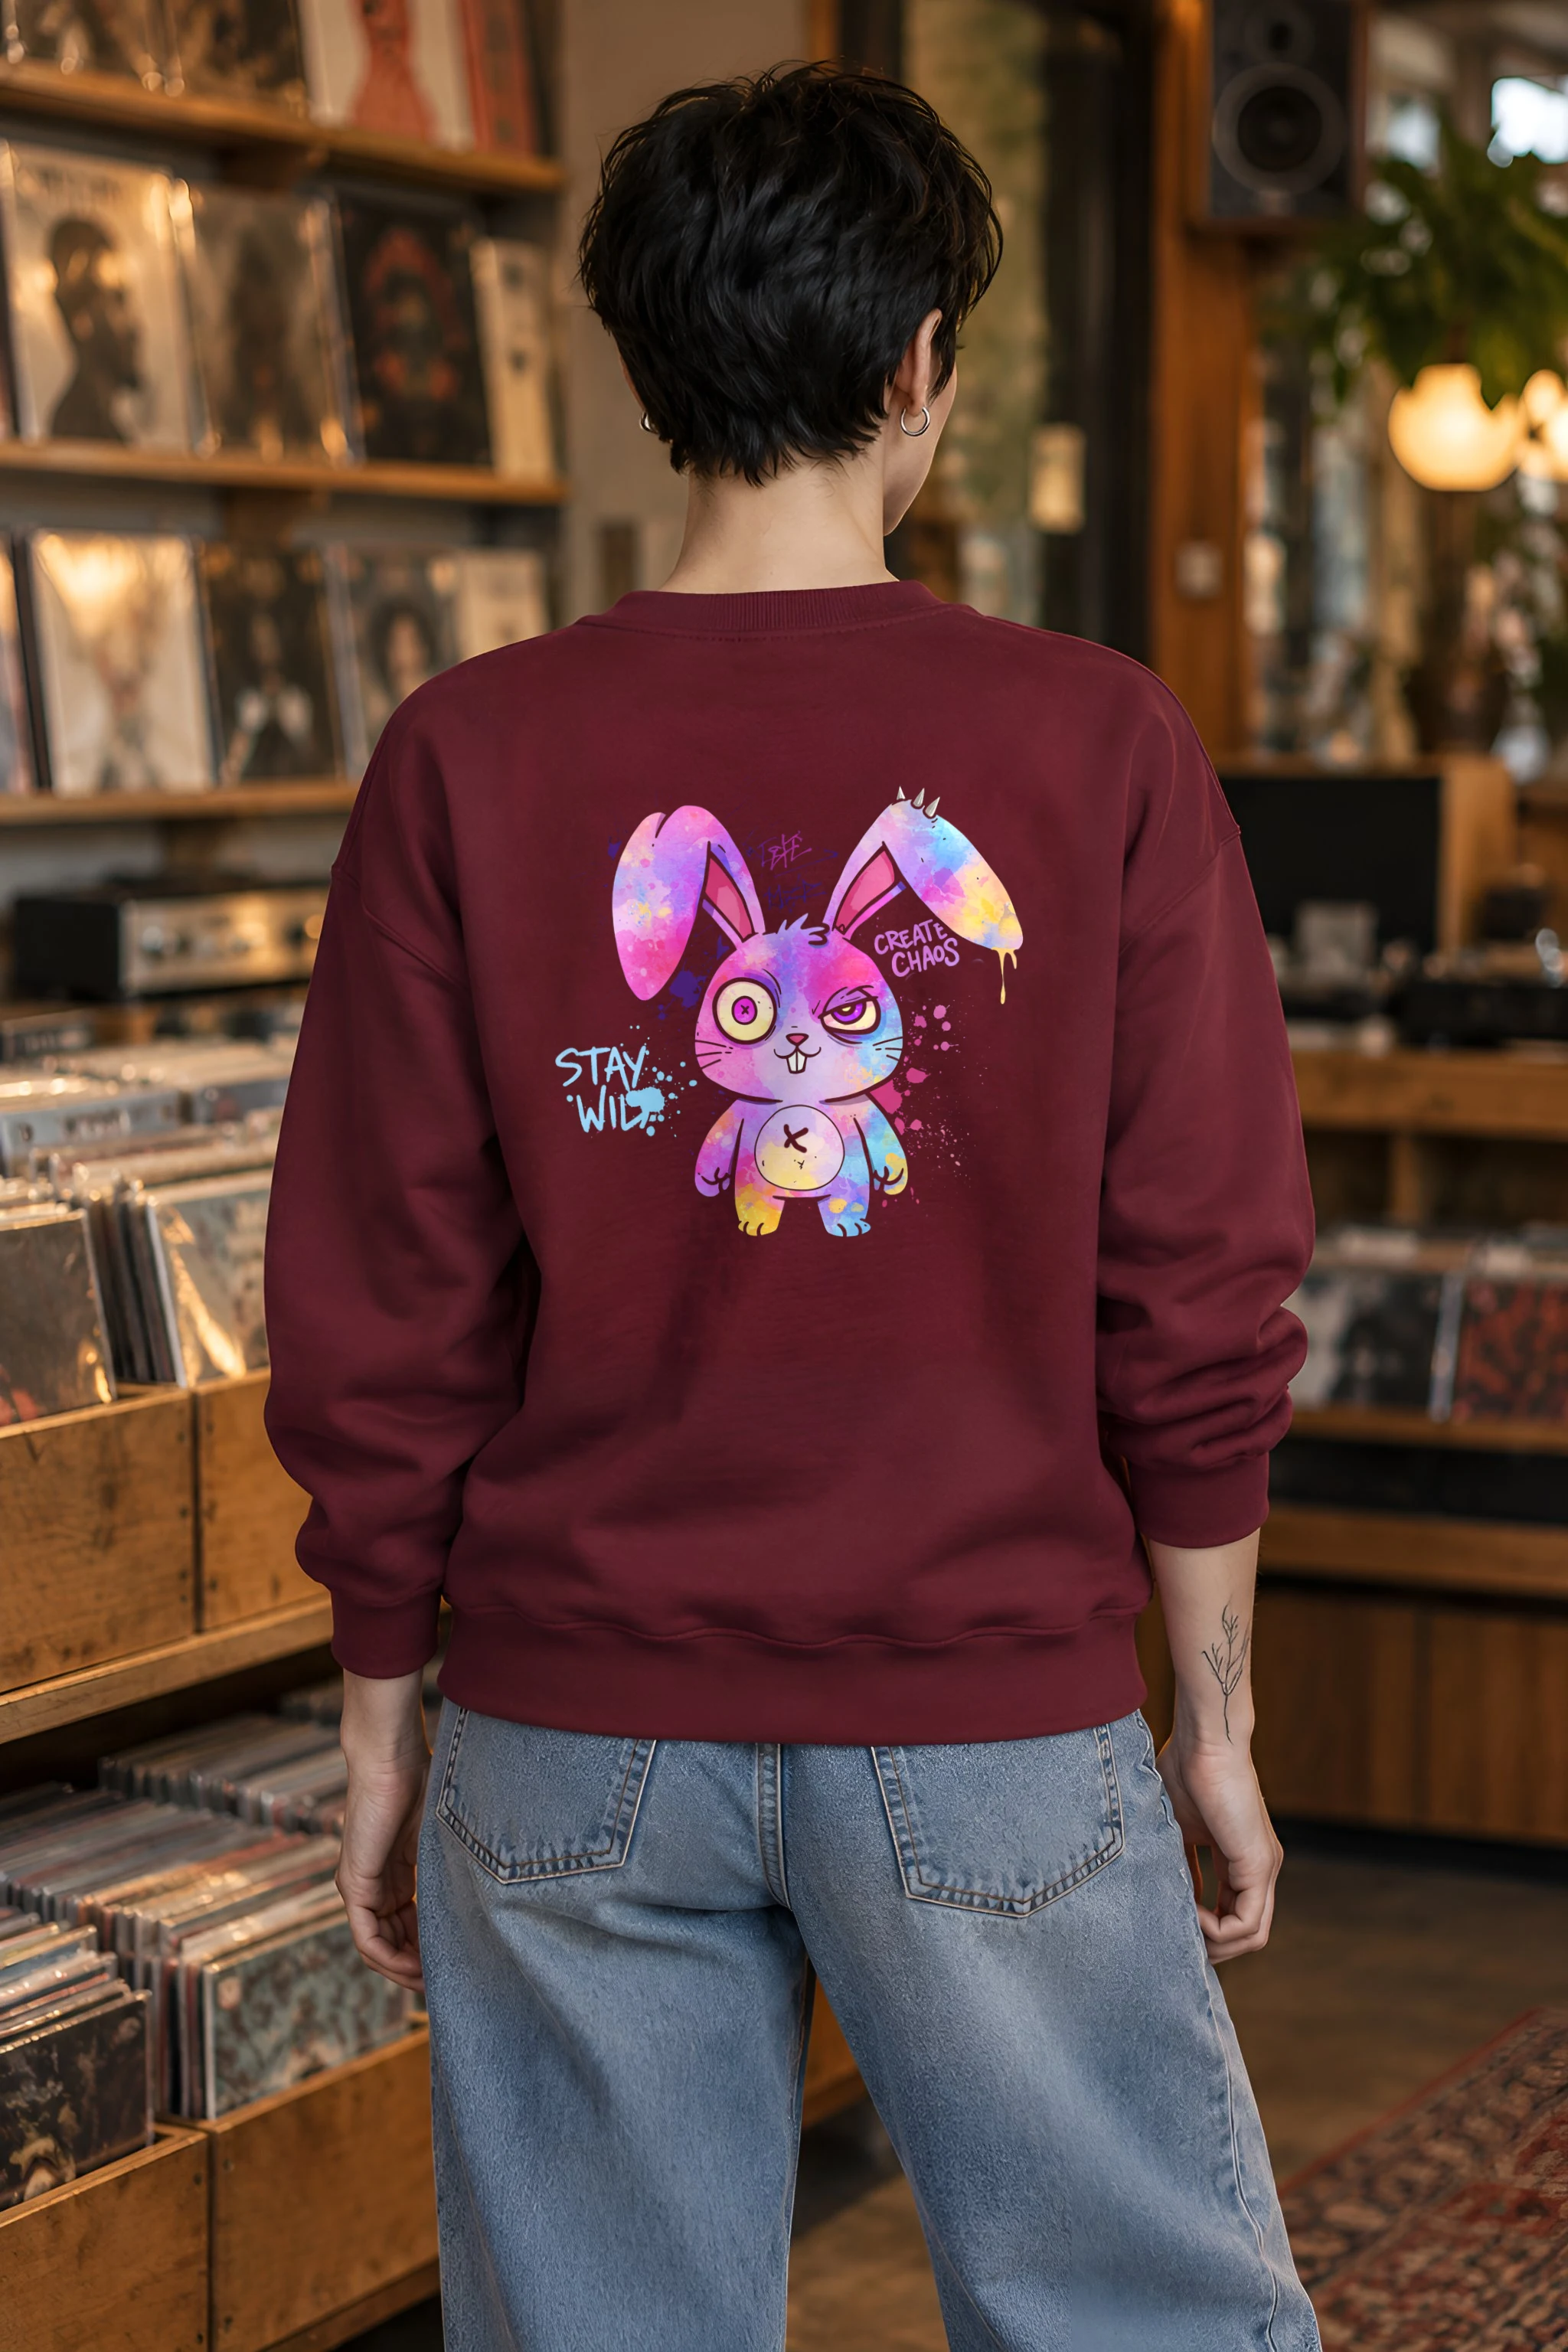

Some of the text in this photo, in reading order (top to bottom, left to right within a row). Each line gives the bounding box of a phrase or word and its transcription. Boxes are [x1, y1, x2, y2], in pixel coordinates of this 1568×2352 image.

[874, 919, 948, 956] CREATE
[891, 937, 960, 978] CHAOS
[555, 1045, 646, 1092] STAY
[576, 1084, 658, 1133] WIL
